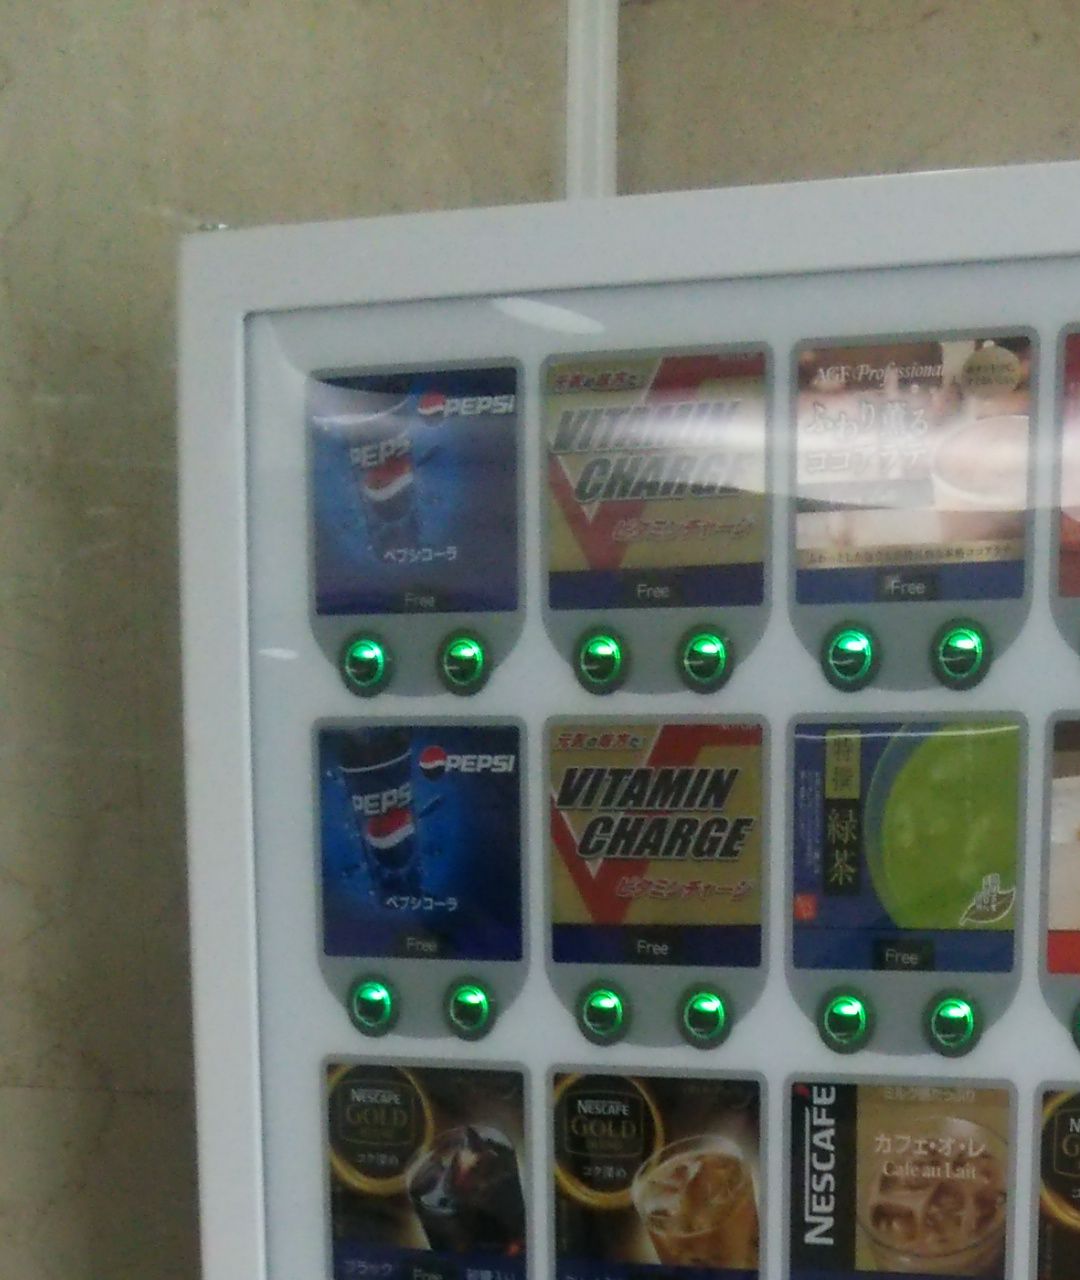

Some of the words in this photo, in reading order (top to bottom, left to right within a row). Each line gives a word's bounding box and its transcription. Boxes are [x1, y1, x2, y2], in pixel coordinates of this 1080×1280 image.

[815, 365, 849, 383] AGF
[853, 361, 945, 388] Professional
[443, 394, 515, 417] PEPSI
[384, 546, 457, 563] ペプシコーラ
[637, 583, 670, 599] Free
[891, 579, 925, 594] Free
[405, 592, 434, 607] Free
[445, 754, 515, 773] PEPSI
[556, 767, 741, 811] VITAMIN
[576, 815, 755, 861] CHARGE
[386, 896, 458, 912] ペプシコーラ
[406, 937, 438, 952] Free
[637, 939, 669, 956] Free
[885, 949, 919, 965] Free
[571, 1118, 636, 1138] GOLD
